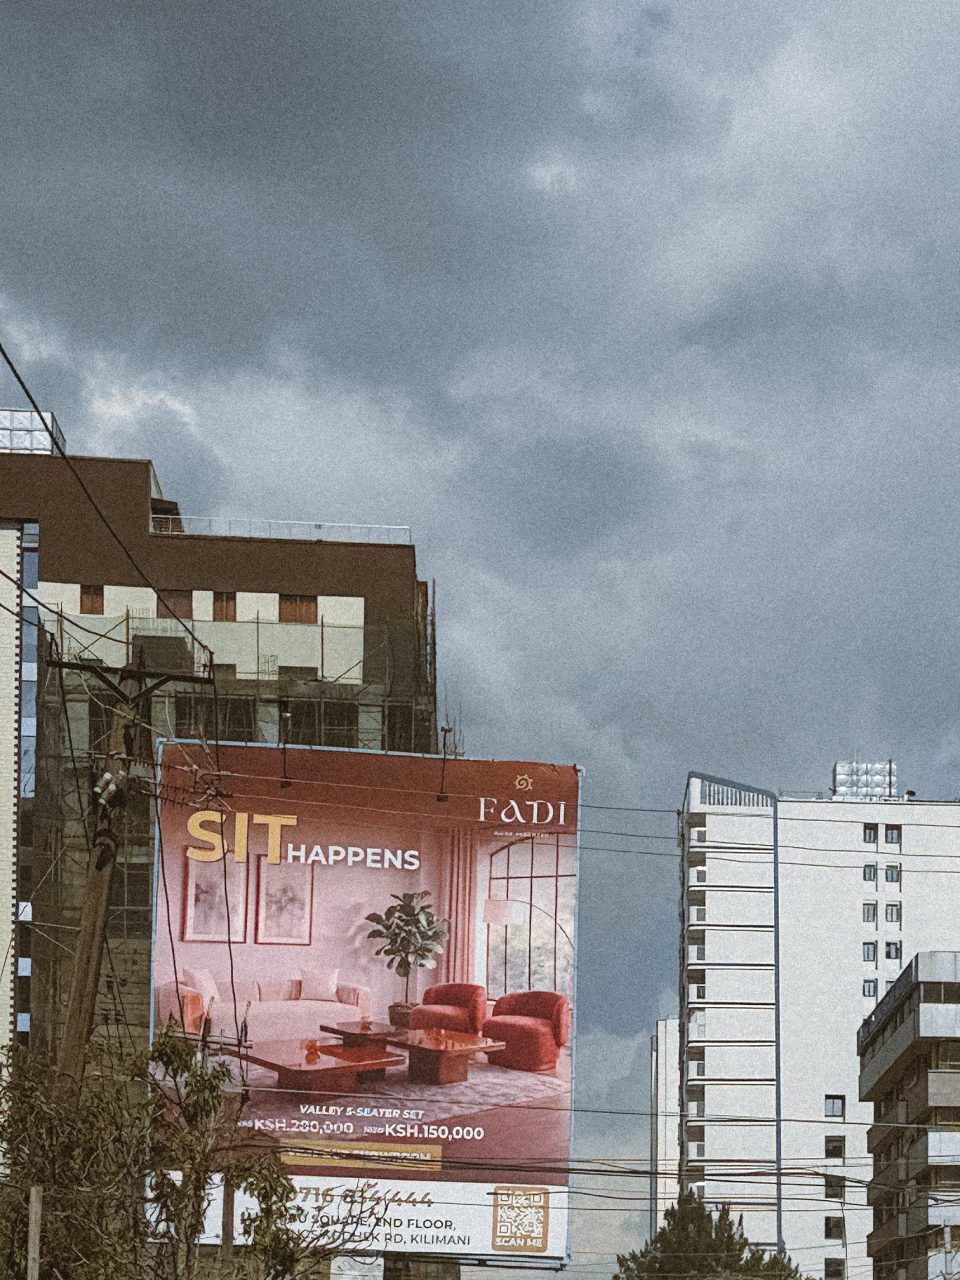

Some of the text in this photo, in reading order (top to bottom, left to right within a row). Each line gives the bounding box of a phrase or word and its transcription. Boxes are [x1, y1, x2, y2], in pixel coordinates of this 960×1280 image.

[479, 797, 566, 825] FADI
[186, 810, 297, 865] SIT
[287, 843, 420, 870] HAPPENS
[300, 1105, 343, 1116] VALLEY
[402, 1110, 424, 1119] SET
[385, 1123, 485, 1141] KSH.150,000
[407, 1218, 456, 1231] FLOOR,
[410, 1233, 470, 1246] KILIMANI
[496, 1237, 524, 1246] SCAN
